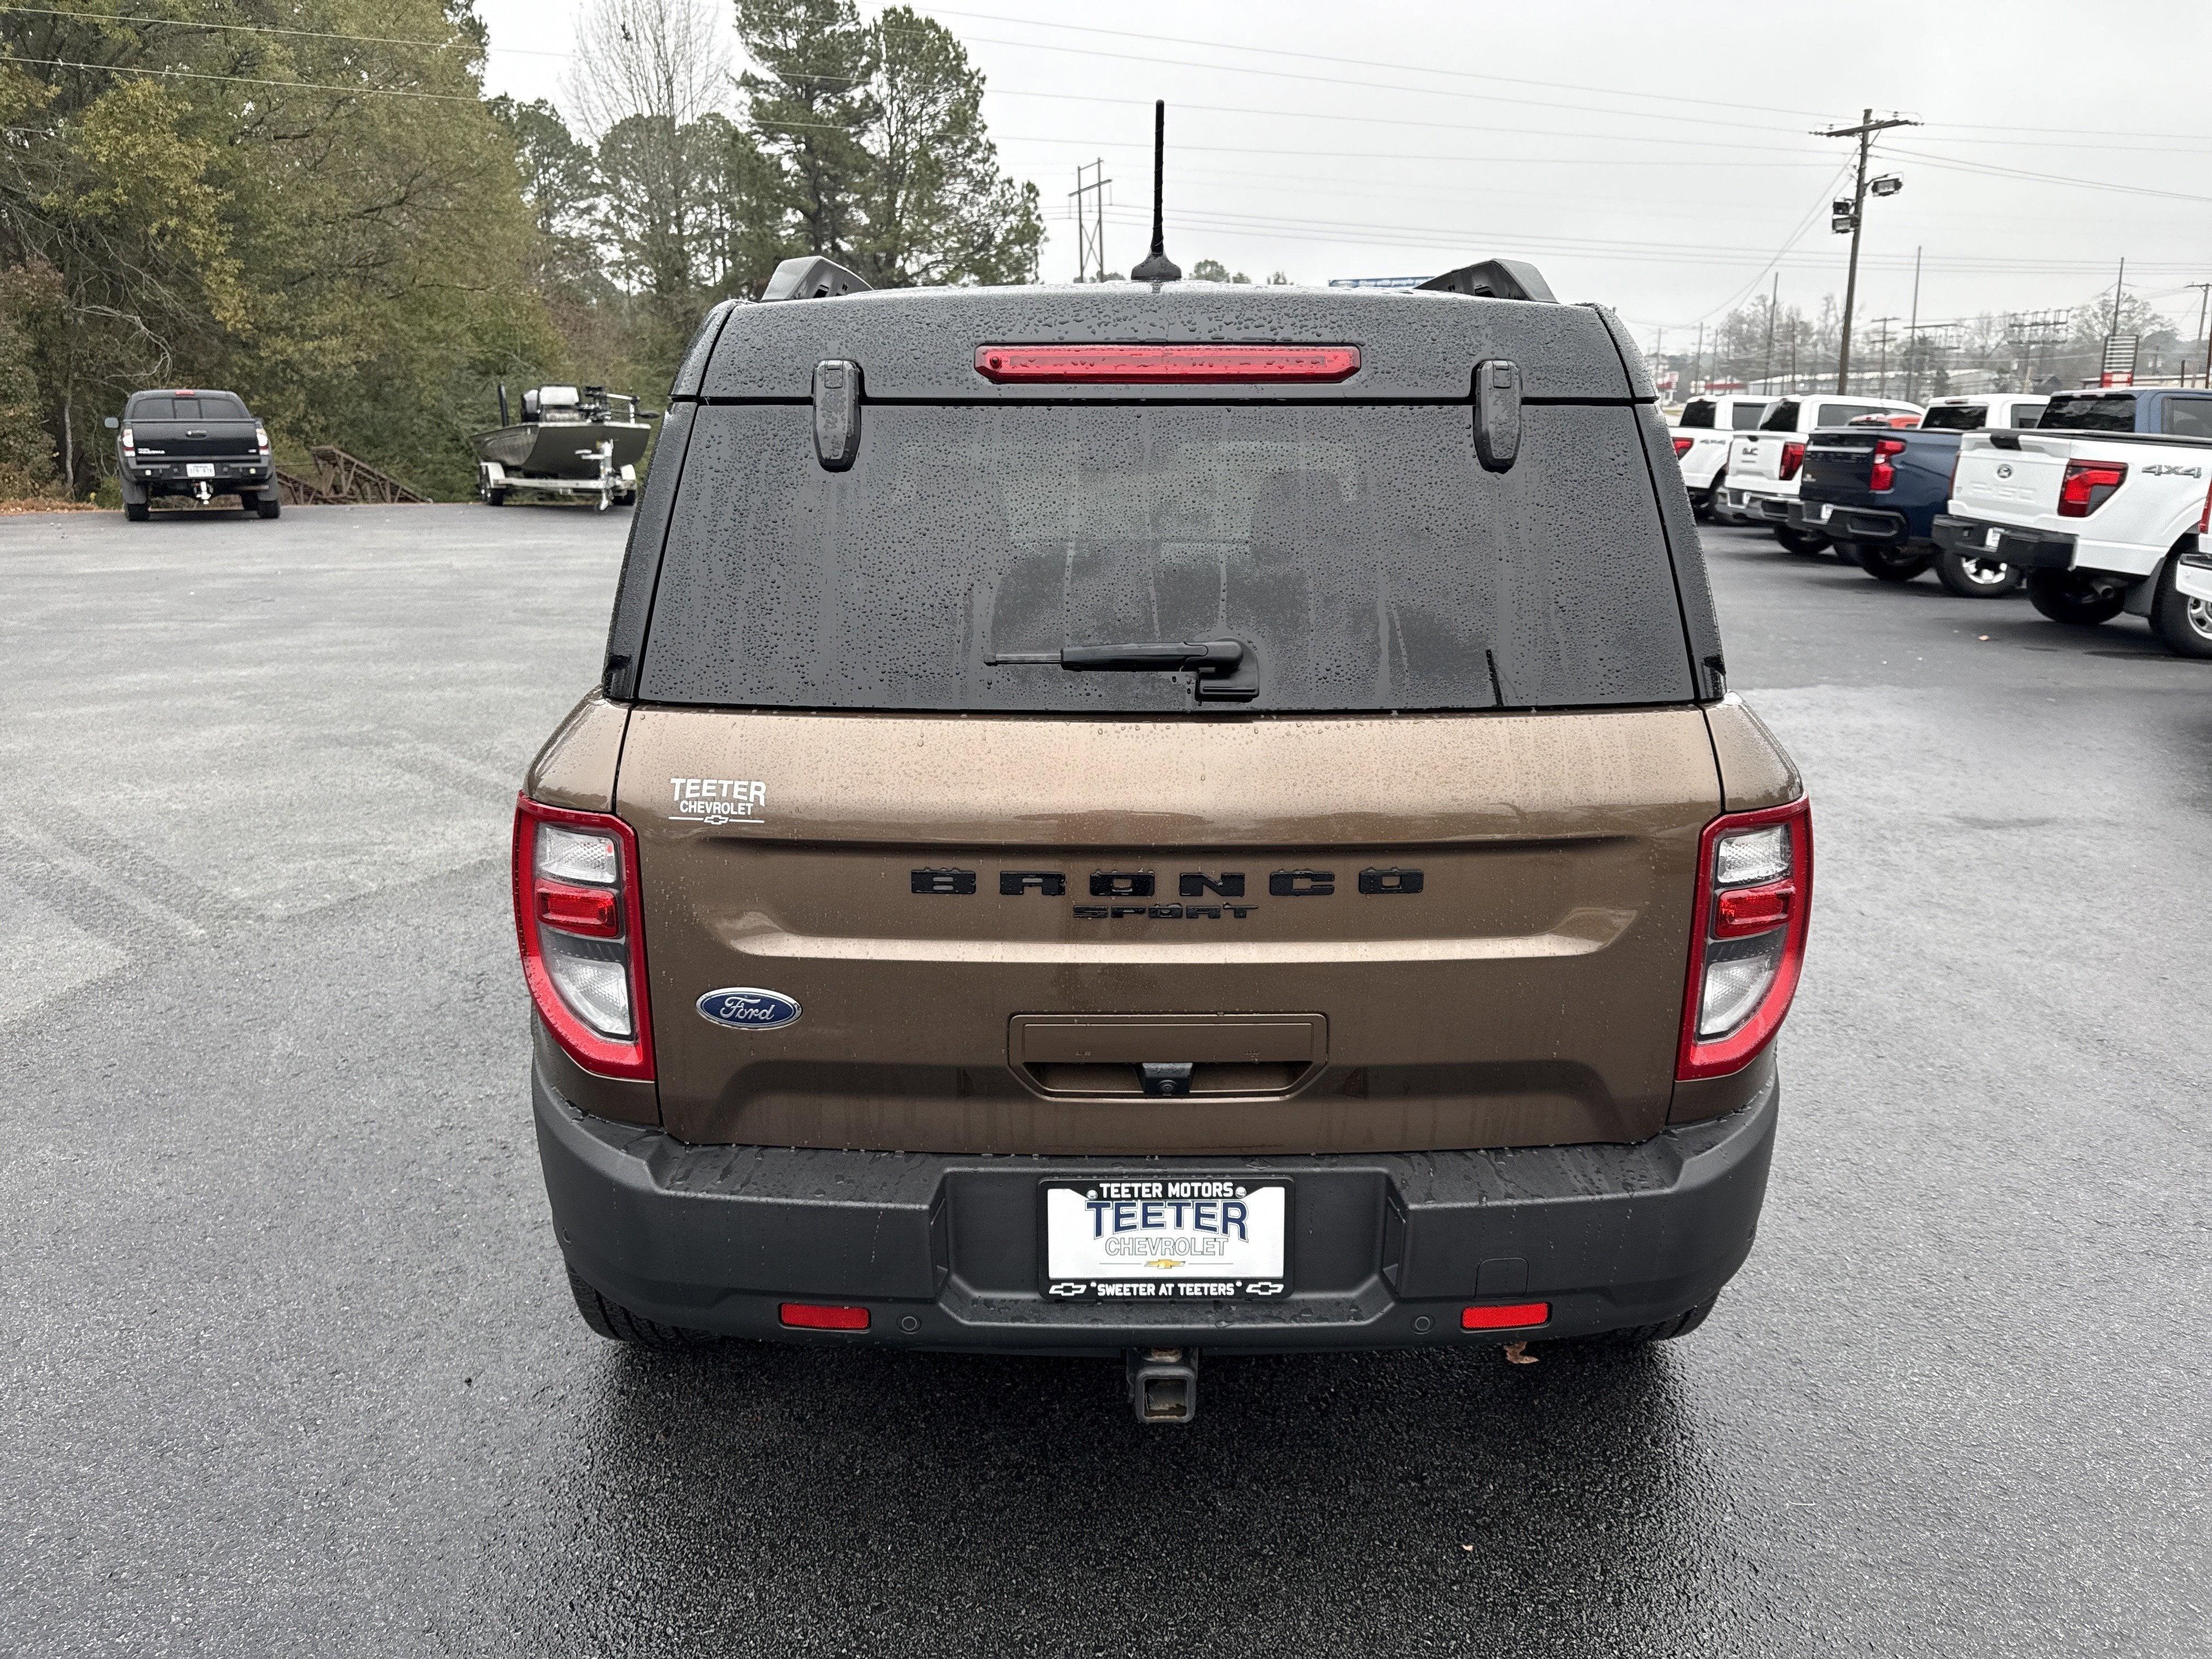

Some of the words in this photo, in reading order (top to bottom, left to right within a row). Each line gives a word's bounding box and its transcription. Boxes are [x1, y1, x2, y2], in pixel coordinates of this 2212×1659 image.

[670, 778, 766, 806] TEETER
[680, 800, 754, 815] CHEVROLET
[911, 869, 1424, 896] BRONCO
[1073, 904, 1259, 918] SPORT
[720, 996, 775, 1020] Ford
[1099, 1182, 1163, 1198] TEETER
[1167, 1182, 1234, 1198] MOTORS
[1085, 1200, 1249, 1243] TEETER
[1105, 1237, 1229, 1256] CHEVROLET
[1097, 1283, 1155, 1296] SWEETER
[1158, 1283, 1175, 1296] AT
[1177, 1283, 1234, 1296] TEETERS
